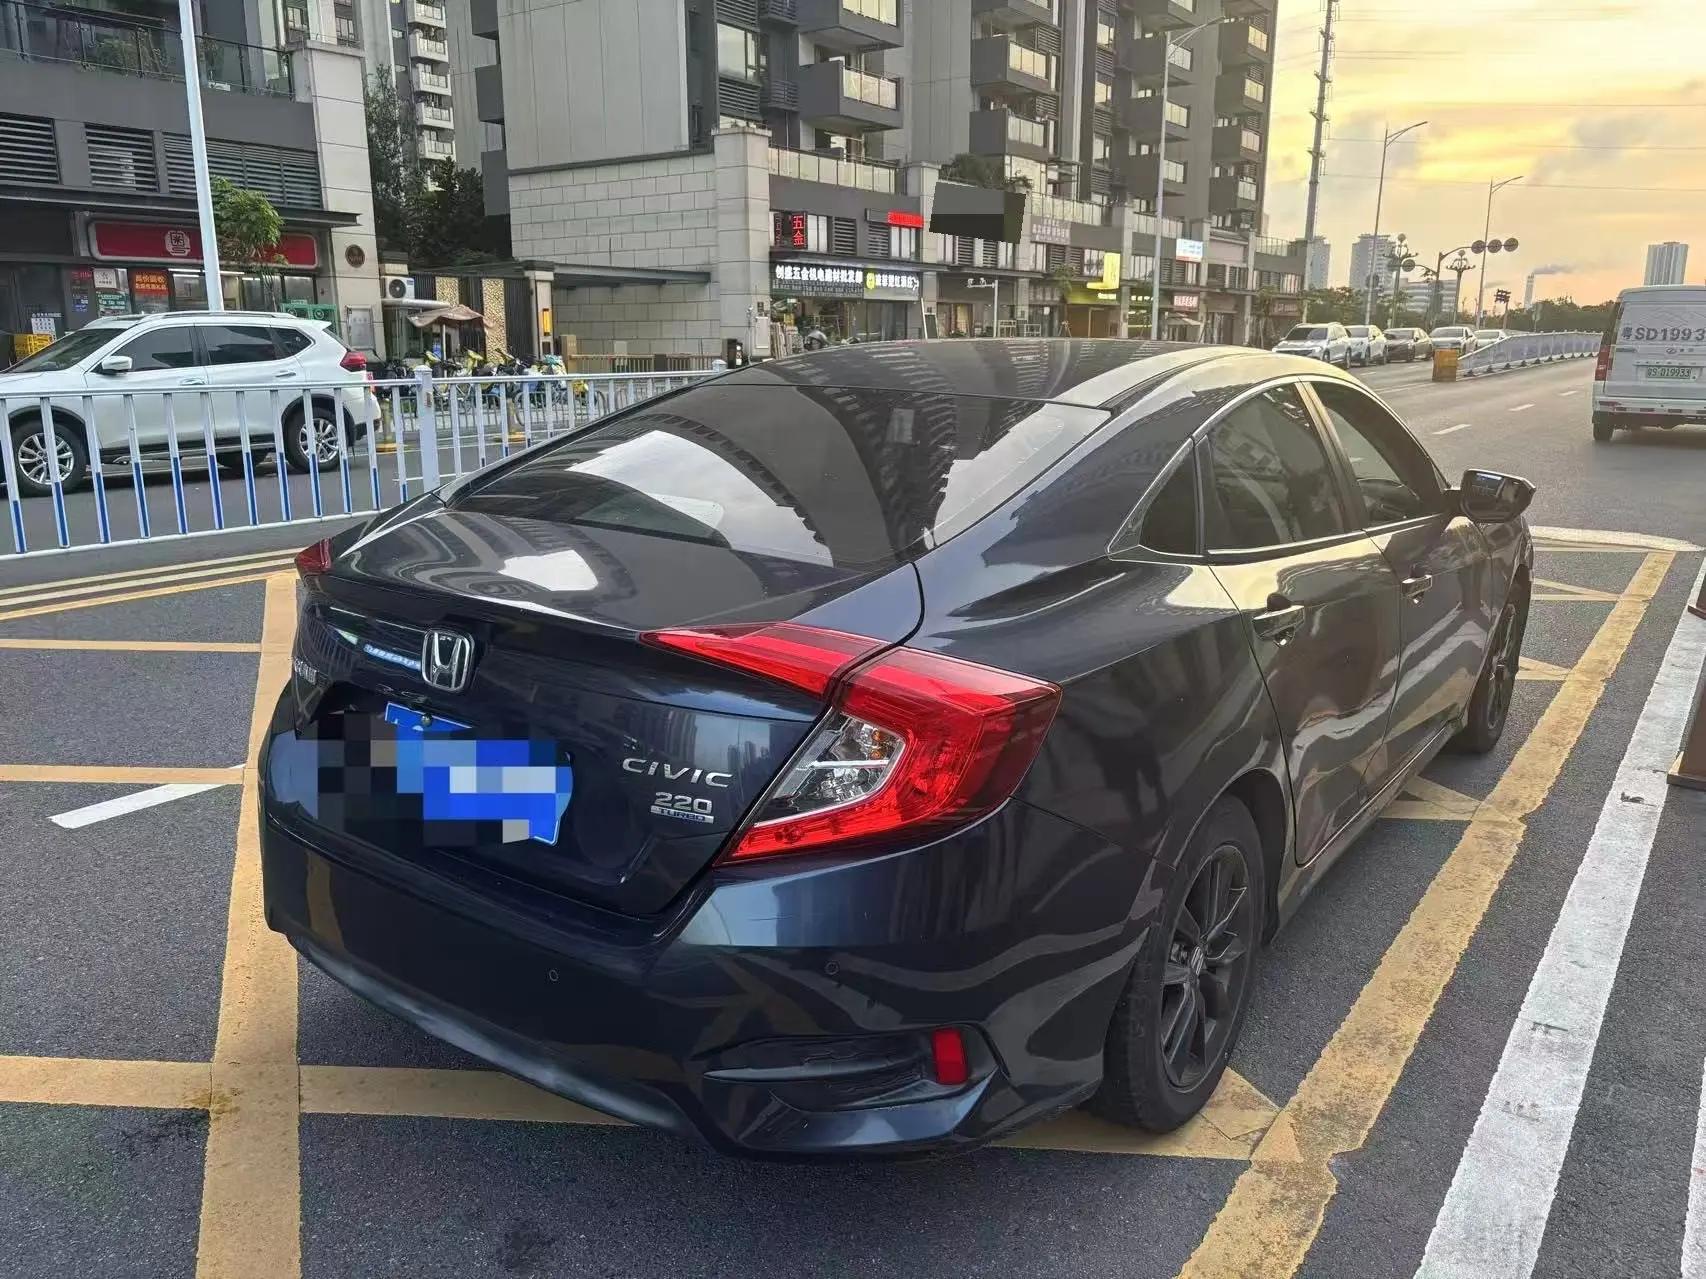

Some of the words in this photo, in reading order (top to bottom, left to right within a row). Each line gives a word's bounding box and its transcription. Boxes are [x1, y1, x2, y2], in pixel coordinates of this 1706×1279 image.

[792, 215, 804, 246] 五金
[622, 757, 733, 788] CIVIC
[654, 791, 713, 814] 220
